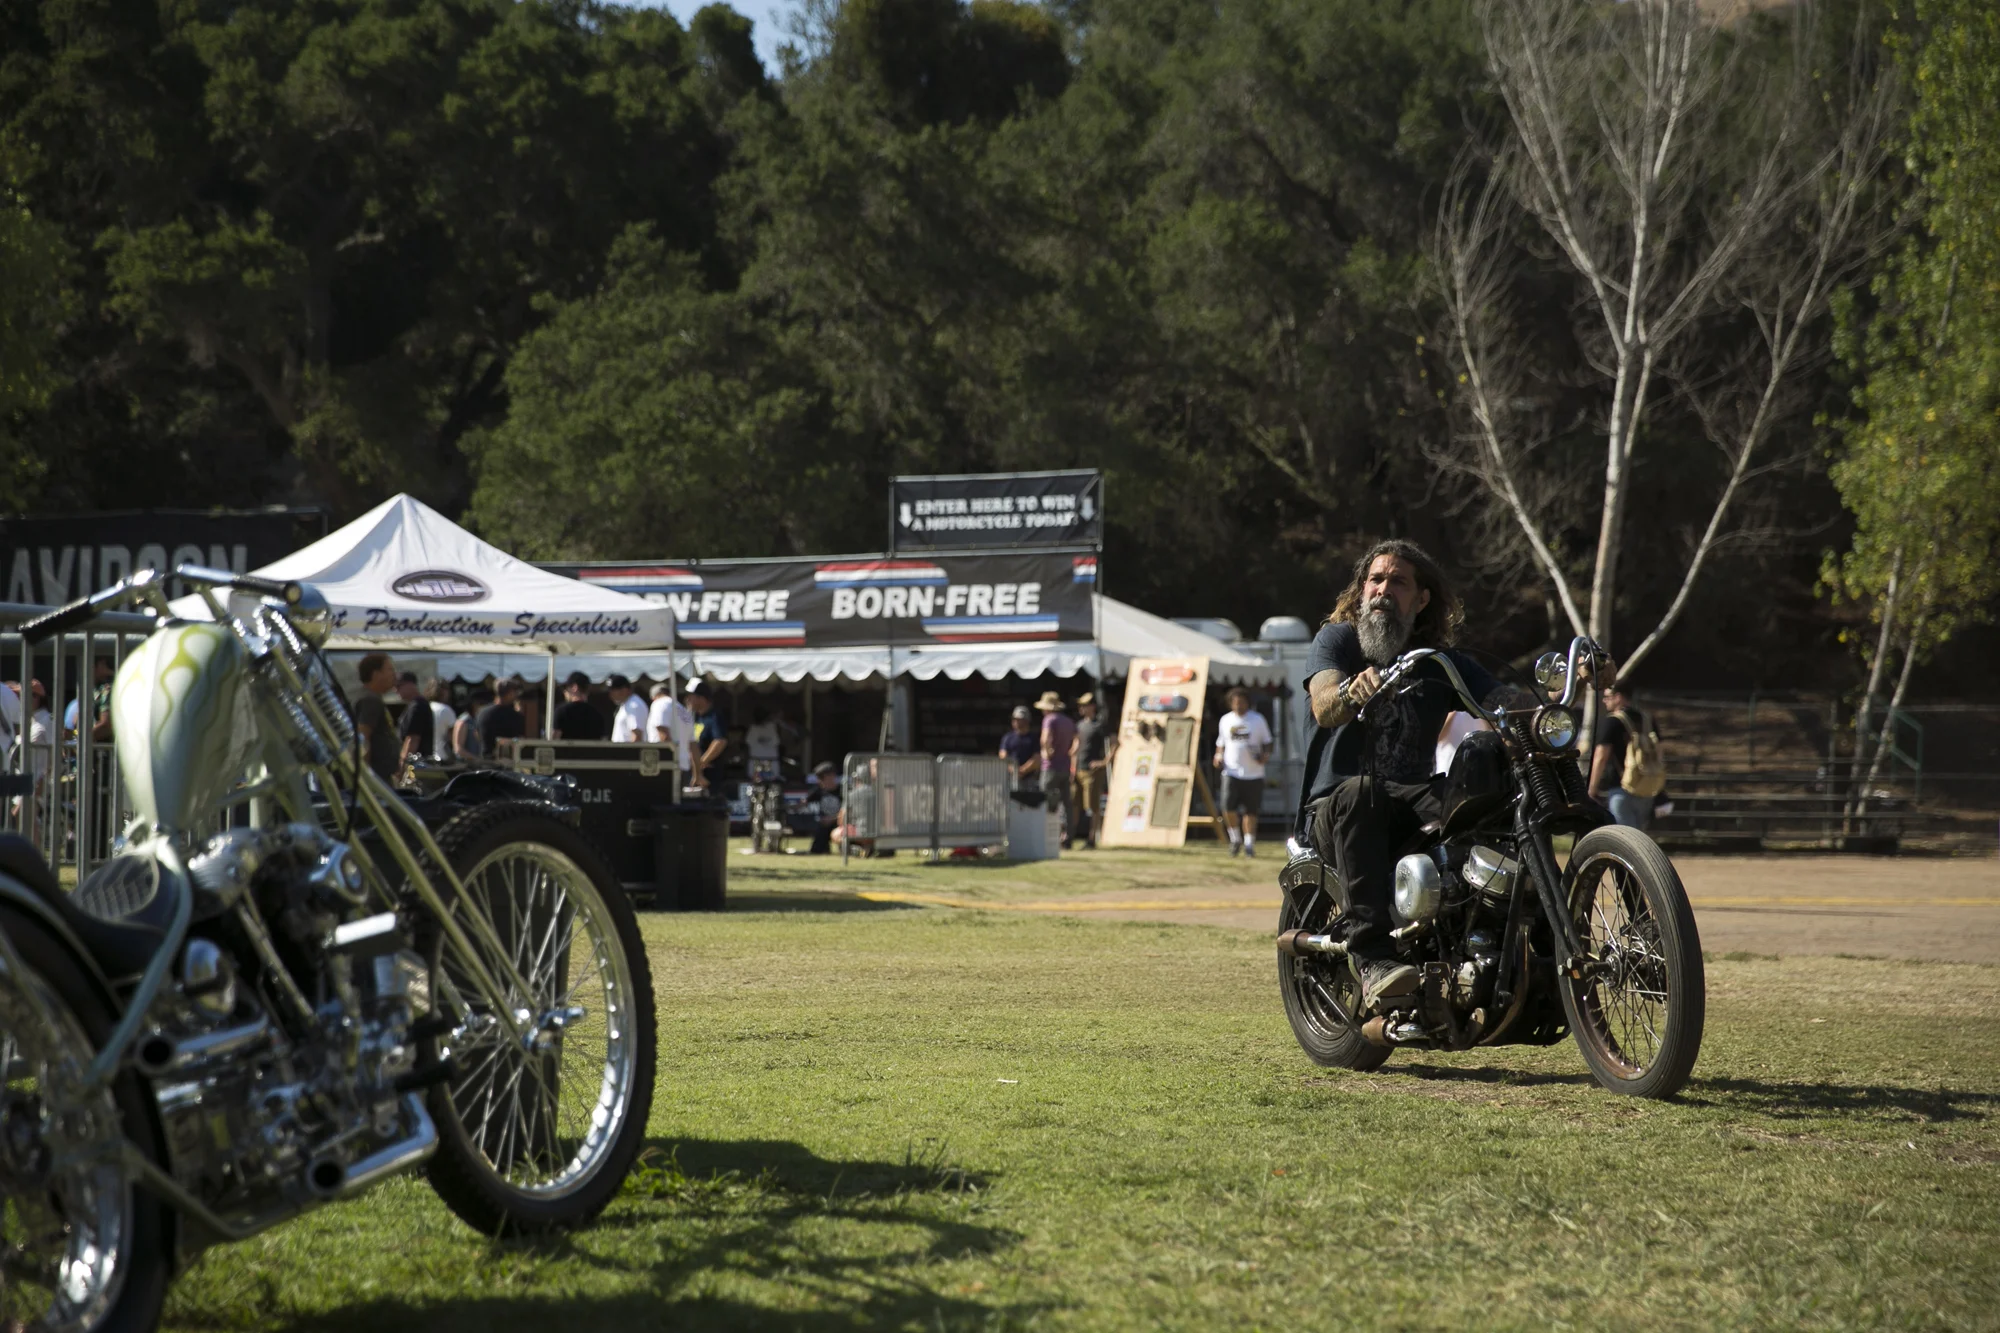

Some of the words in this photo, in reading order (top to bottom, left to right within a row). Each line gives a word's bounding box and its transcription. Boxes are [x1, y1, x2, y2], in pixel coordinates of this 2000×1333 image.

[915, 498, 967, 515] ENTER
[970, 497, 1014, 513] HERE
[1016, 495, 1038, 512] TO
[1041, 494, 1076, 510] WIN
[911, 517, 924, 531] A
[831, 582, 1041, 619] BORN-FREE
[364, 608, 495, 635] Production
[511, 611, 640, 639] Specialists
